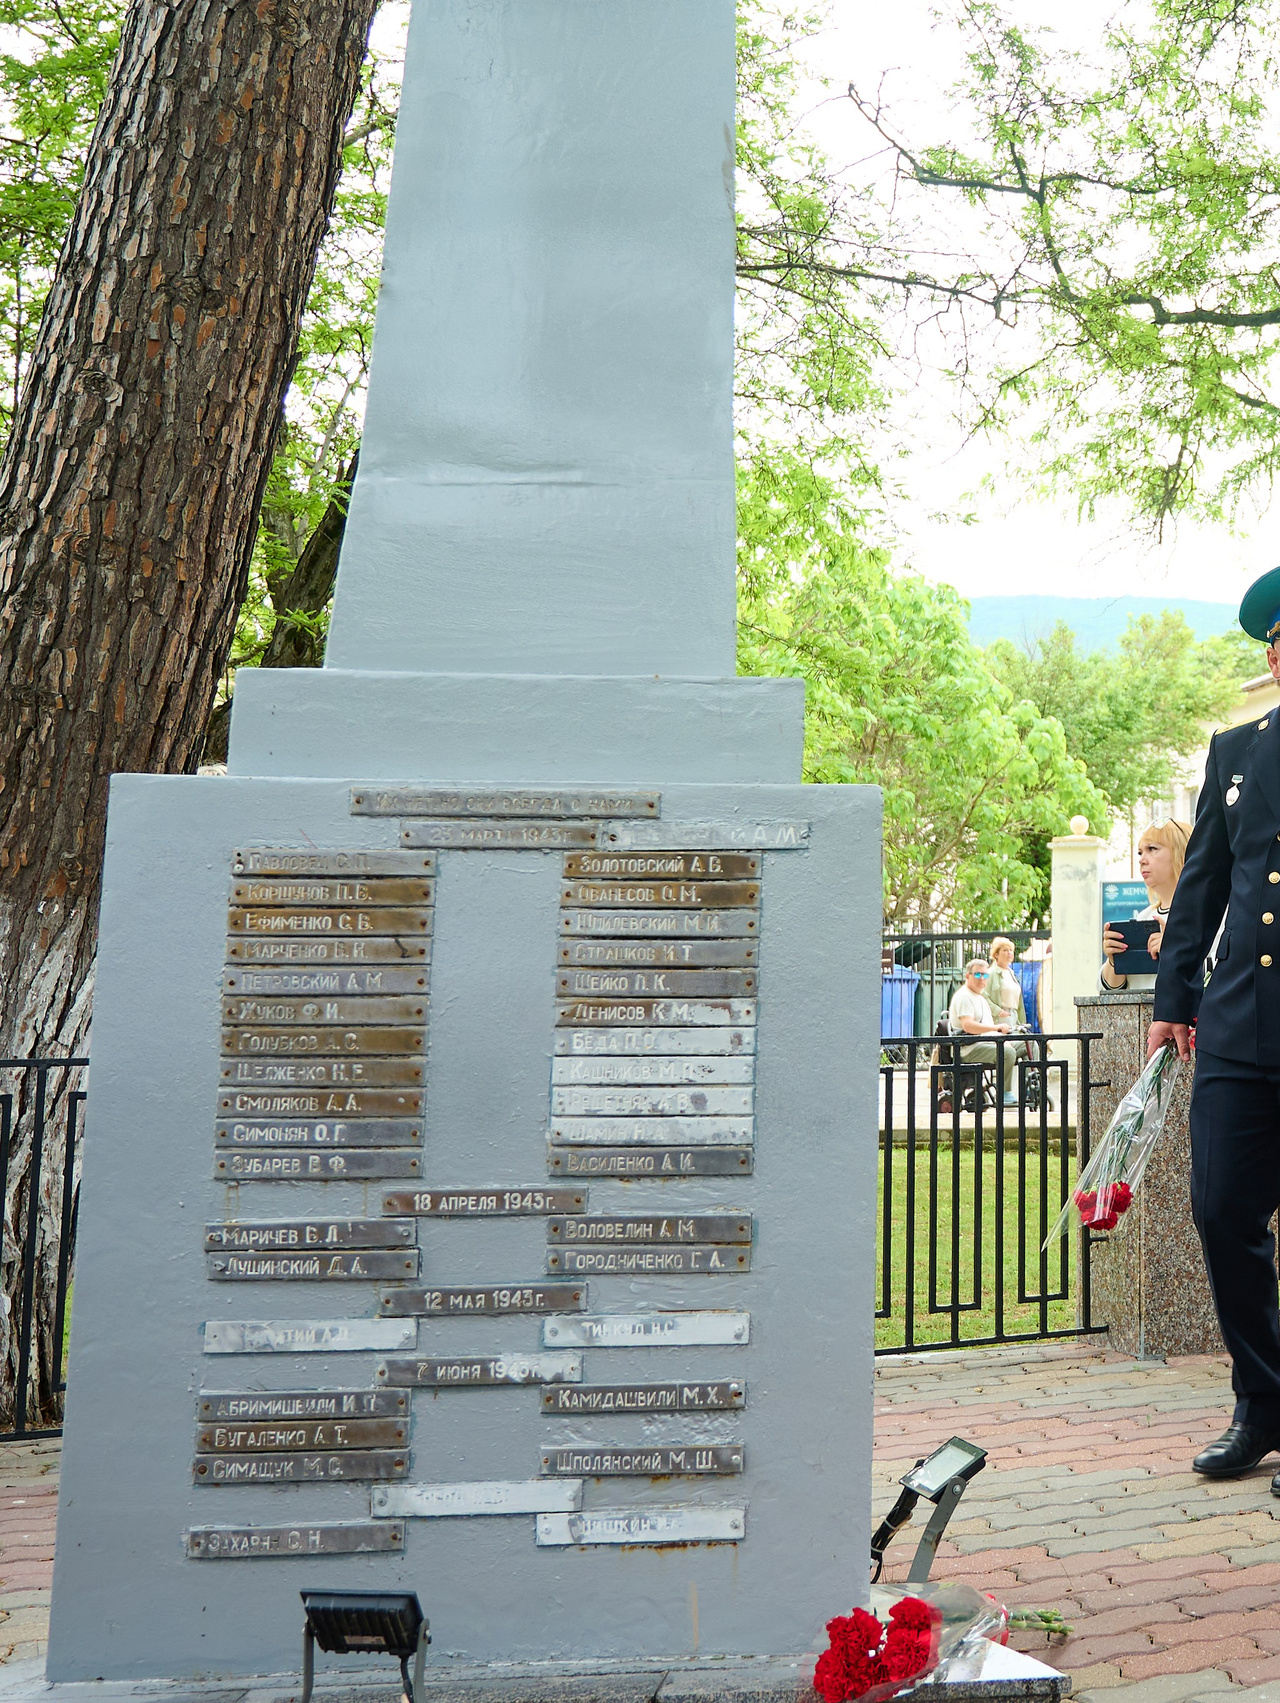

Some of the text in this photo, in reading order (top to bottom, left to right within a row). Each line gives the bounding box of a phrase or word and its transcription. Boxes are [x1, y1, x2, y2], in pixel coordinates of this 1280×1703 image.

[413, 1193, 432, 1211] 18
[424, 1292, 443, 1310] 12
[416, 1363, 428, 1381] 7
